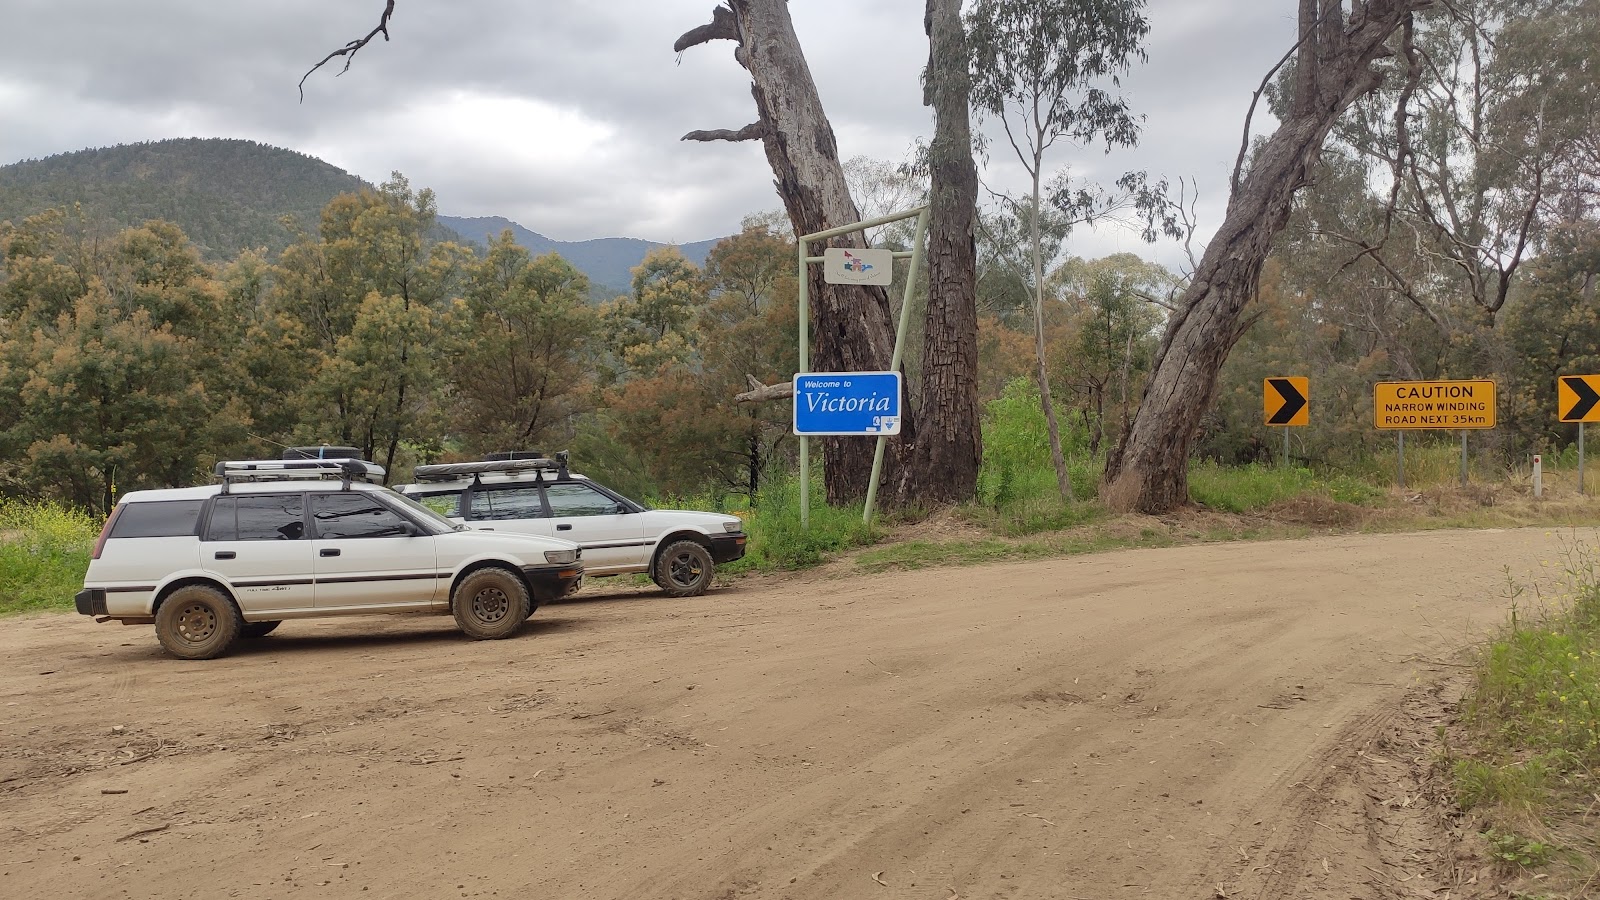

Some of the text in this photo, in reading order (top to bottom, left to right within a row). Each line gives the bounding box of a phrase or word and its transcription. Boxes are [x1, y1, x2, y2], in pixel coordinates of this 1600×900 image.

[804, 380, 852, 389] Welcome to
[1396, 386, 1474, 399] CAUTION
[805, 392, 890, 412] Victoria
[1385, 402, 1486, 412] NARROW WINDING
[1385, 415, 1486, 424] ROAD NEXT 35km
